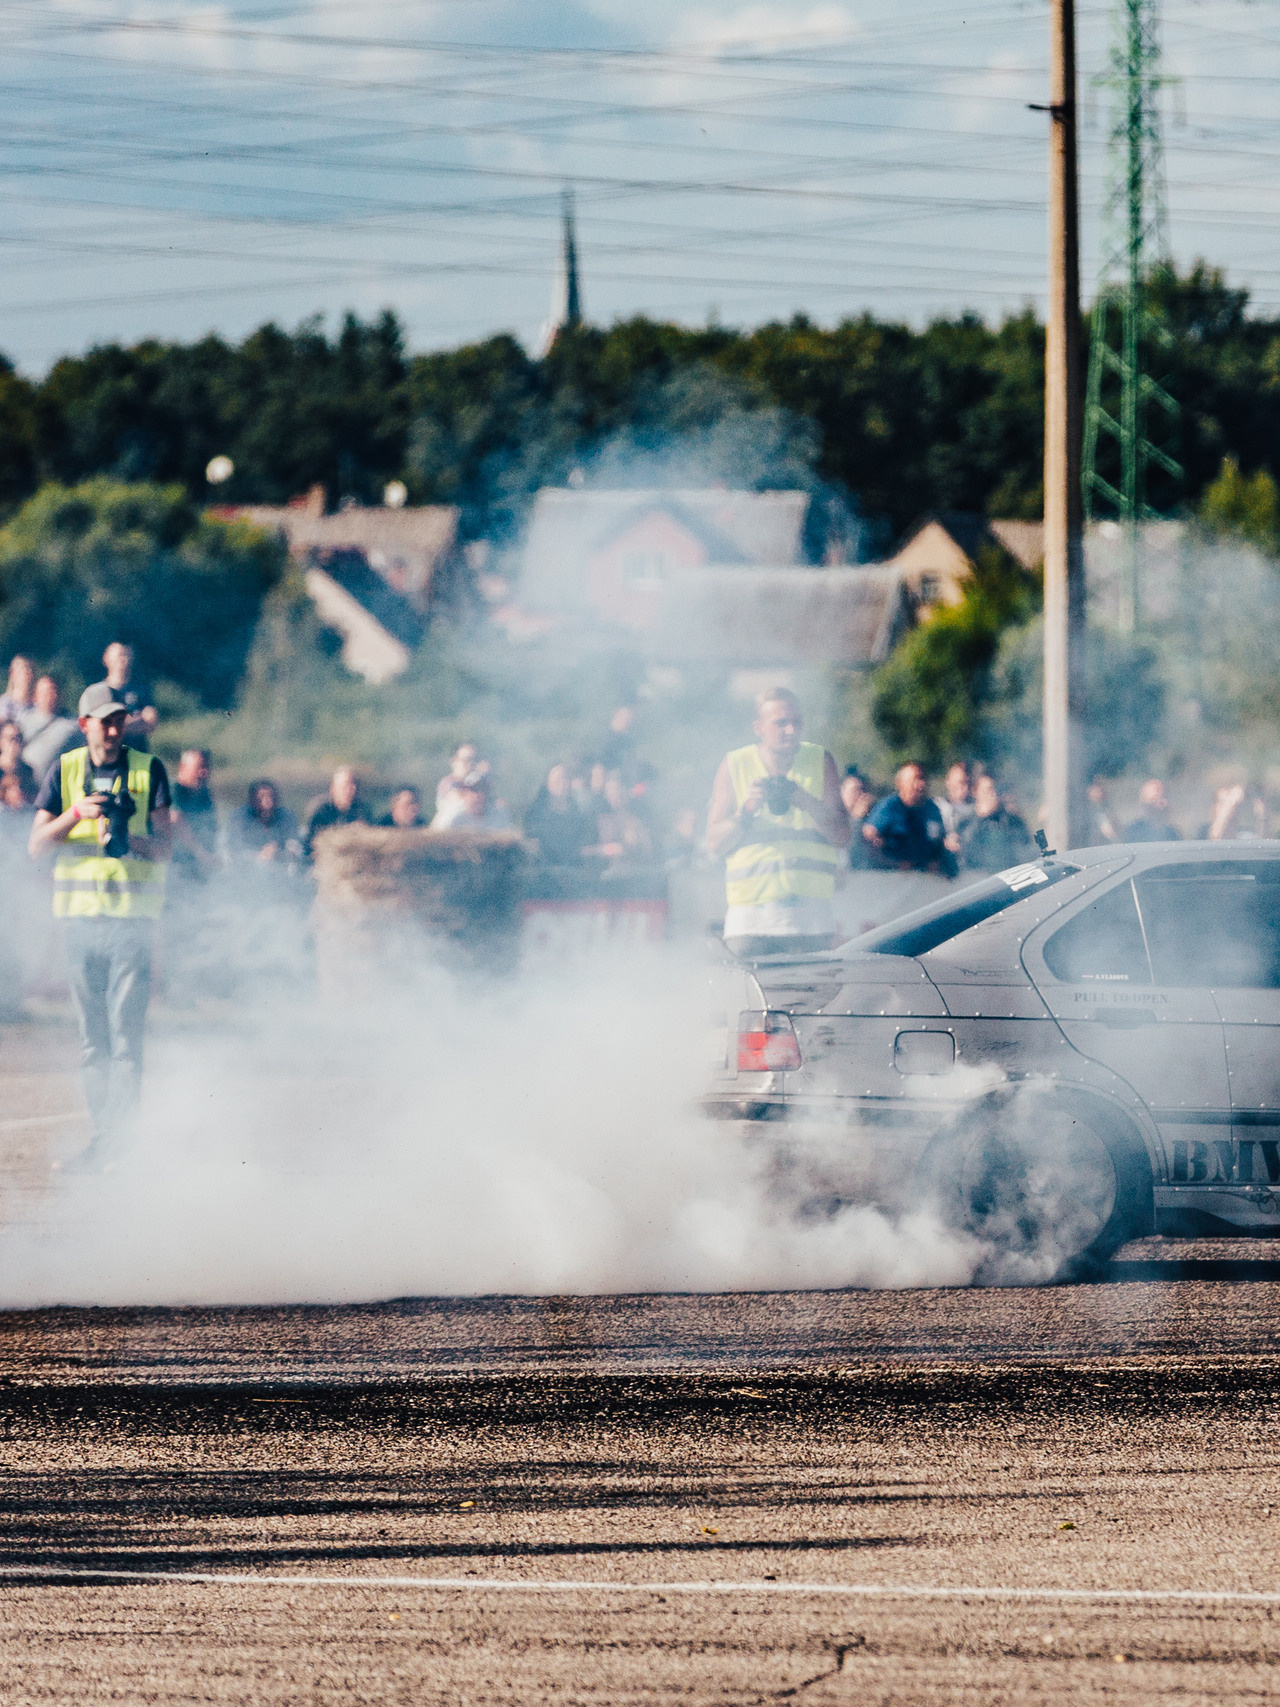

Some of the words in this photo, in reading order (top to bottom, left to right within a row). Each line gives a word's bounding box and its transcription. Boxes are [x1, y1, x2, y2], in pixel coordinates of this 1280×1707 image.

[1073, 992, 1107, 1003] PULL
[1112, 992, 1130, 1003] TO
[1133, 993, 1169, 1004] OPEN
